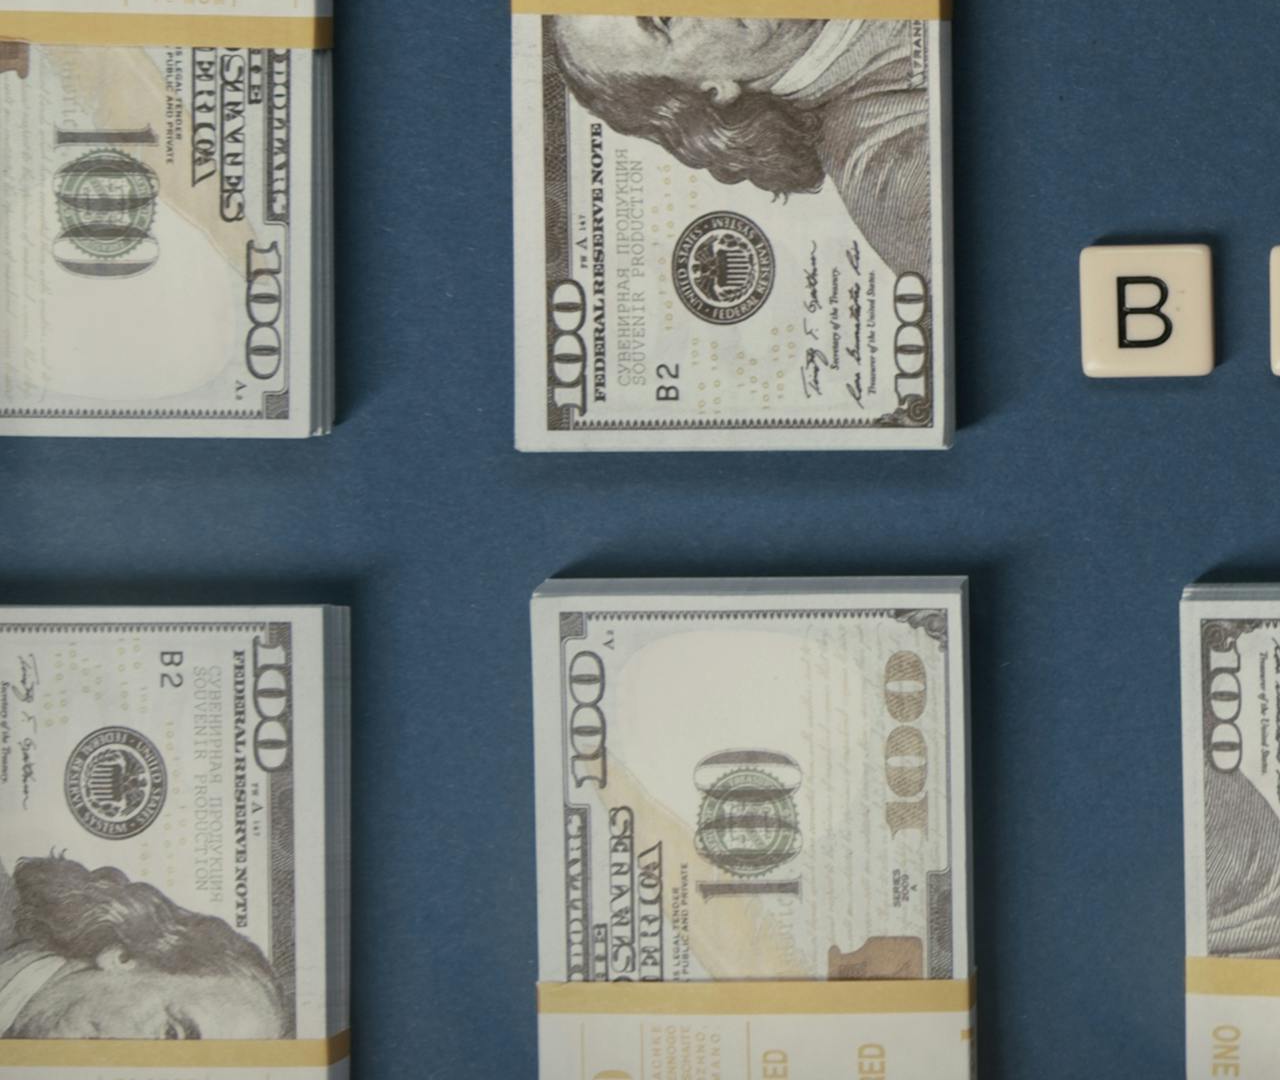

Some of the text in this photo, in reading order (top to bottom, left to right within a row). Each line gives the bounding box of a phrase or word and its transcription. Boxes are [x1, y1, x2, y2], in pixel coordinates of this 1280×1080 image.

[50, 123, 162, 281] 100
[220, 54, 246, 222] STATES
[272, 60, 288, 215] DOLLARS
[244, 238, 283, 382] 100
[589, 123, 606, 402] FEDERAL RESERVE NOTE
[614, 148, 632, 387] СУВЕНИРНАЯ ПРОДУКЦИЯ
[630, 160, 646, 386] SOUVENIR PRODUCTION
[893, 271, 928, 406] 100
[551, 277, 587, 417] 100
[252, 635, 288, 774] 100
[567, 648, 606, 790] 100
[884, 649, 929, 841] 100
[1205, 641, 1243, 775] 100
[233, 649, 248, 928] FEDERAL RESERVE NOTE
[692, 747, 804, 902] 100
[568, 814, 583, 968] DOLLARS
[609, 805, 636, 973] STATES
